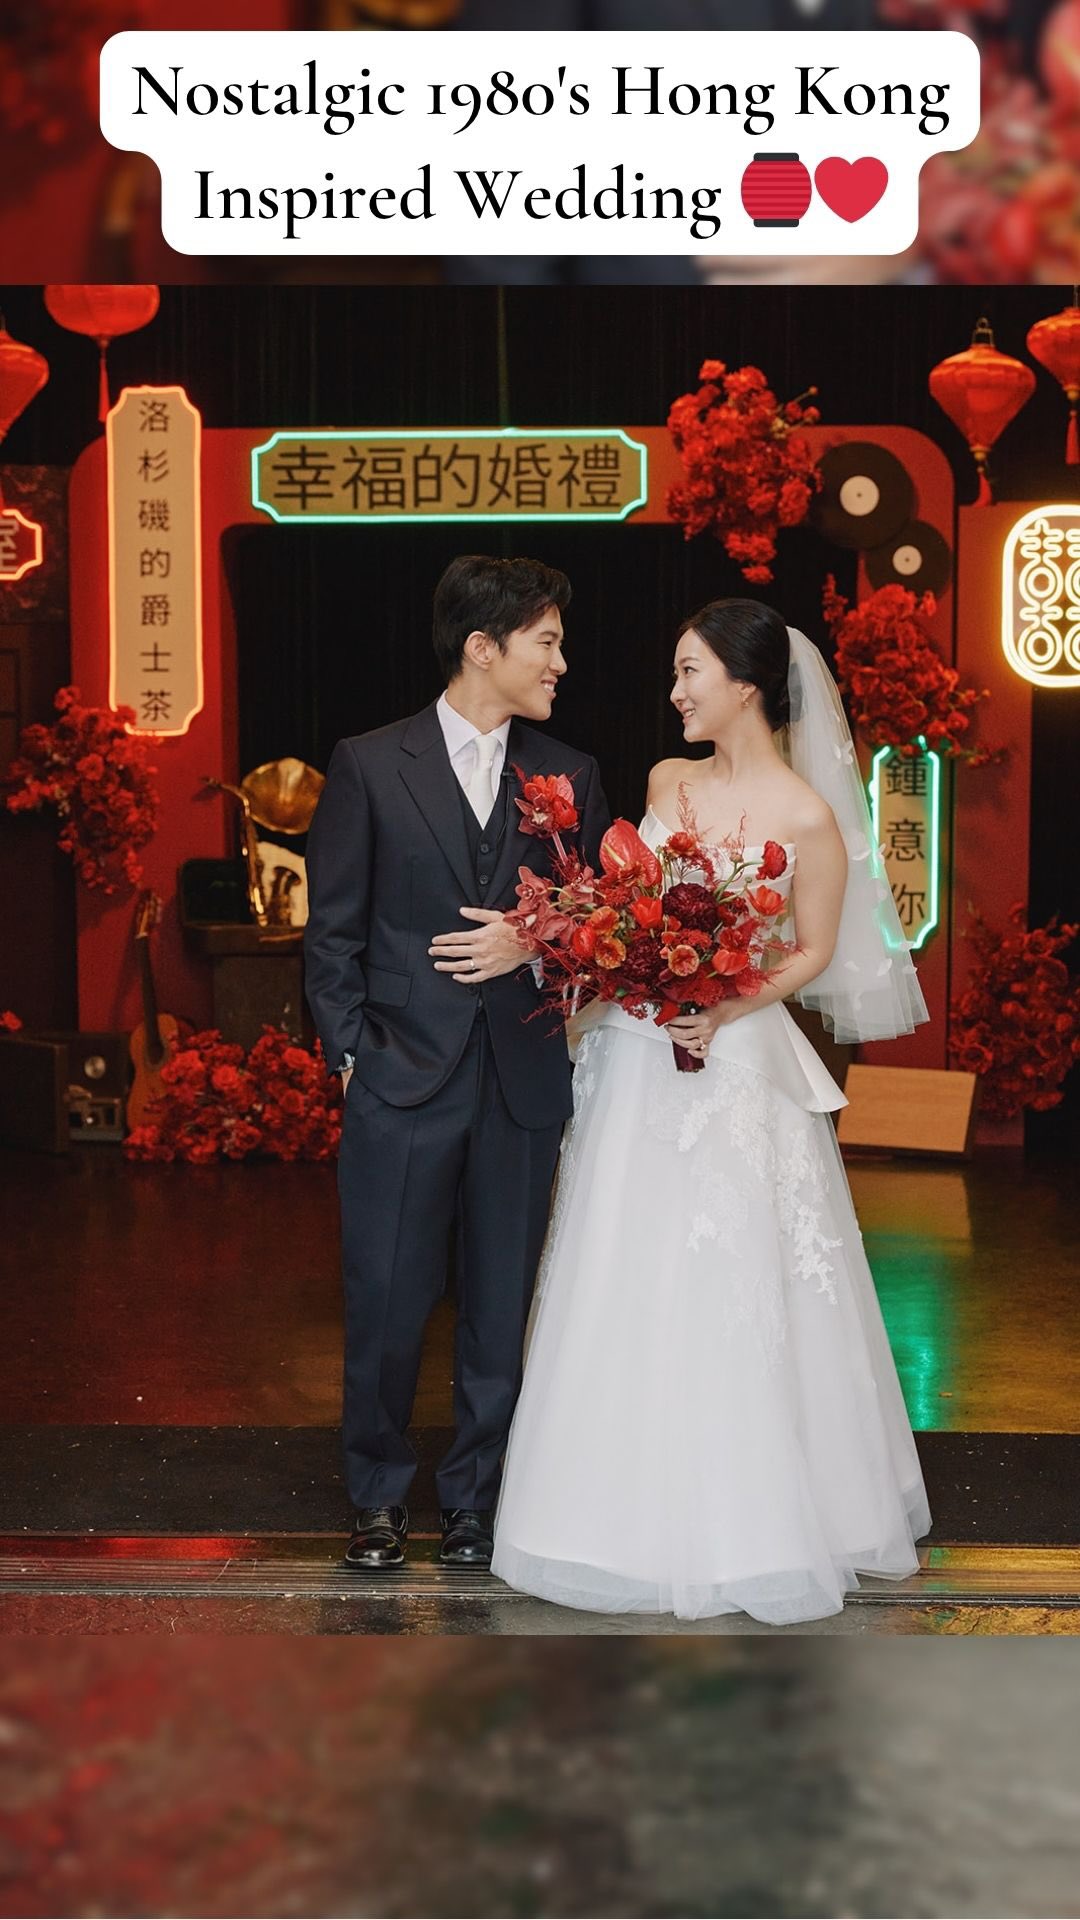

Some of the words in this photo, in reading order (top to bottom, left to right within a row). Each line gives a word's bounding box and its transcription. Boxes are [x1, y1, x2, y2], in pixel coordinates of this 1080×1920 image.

[138, 400, 171, 722] 洛杉磯的爵士茶
[272, 443, 622, 510] 幸福的婚禮
